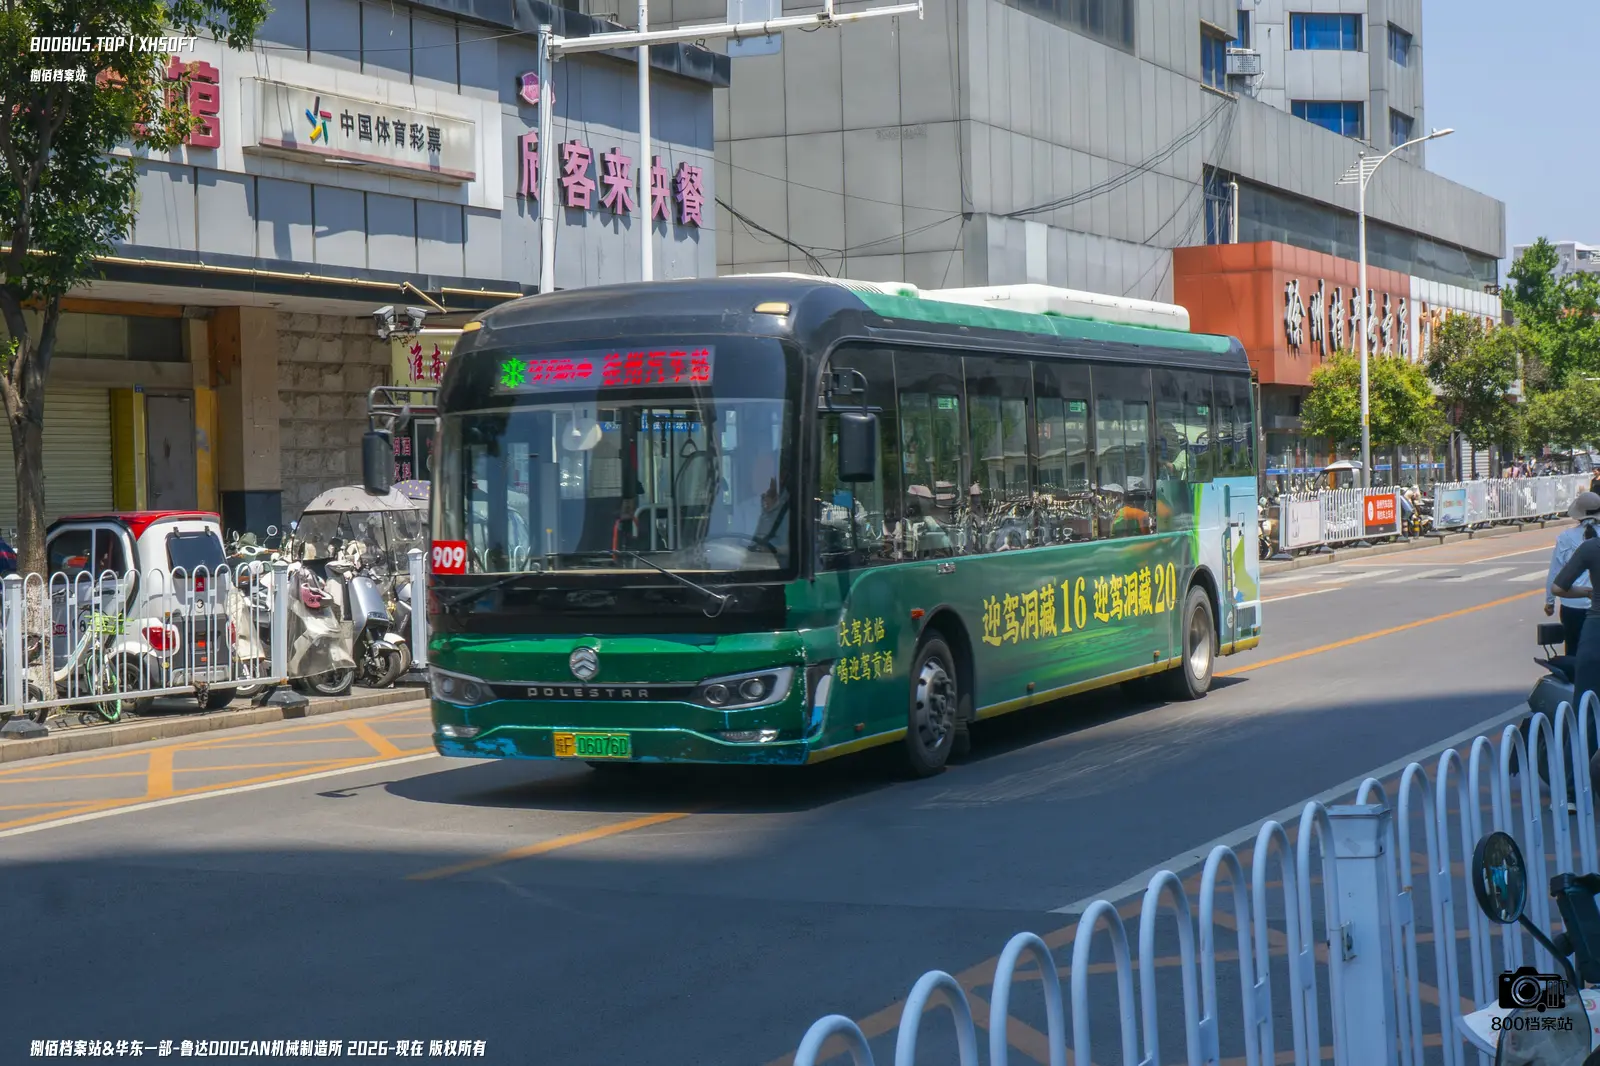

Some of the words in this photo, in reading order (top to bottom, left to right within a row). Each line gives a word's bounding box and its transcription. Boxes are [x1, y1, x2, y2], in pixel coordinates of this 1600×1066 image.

[339, 108, 442, 153] 中国体育彩票
[432, 546, 465, 569] 909
[839, 617, 885, 648] 大驾光临
[836, 650, 893, 685] 喝迎驾贡酒
[526, 686, 650, 699] POLESTAR
